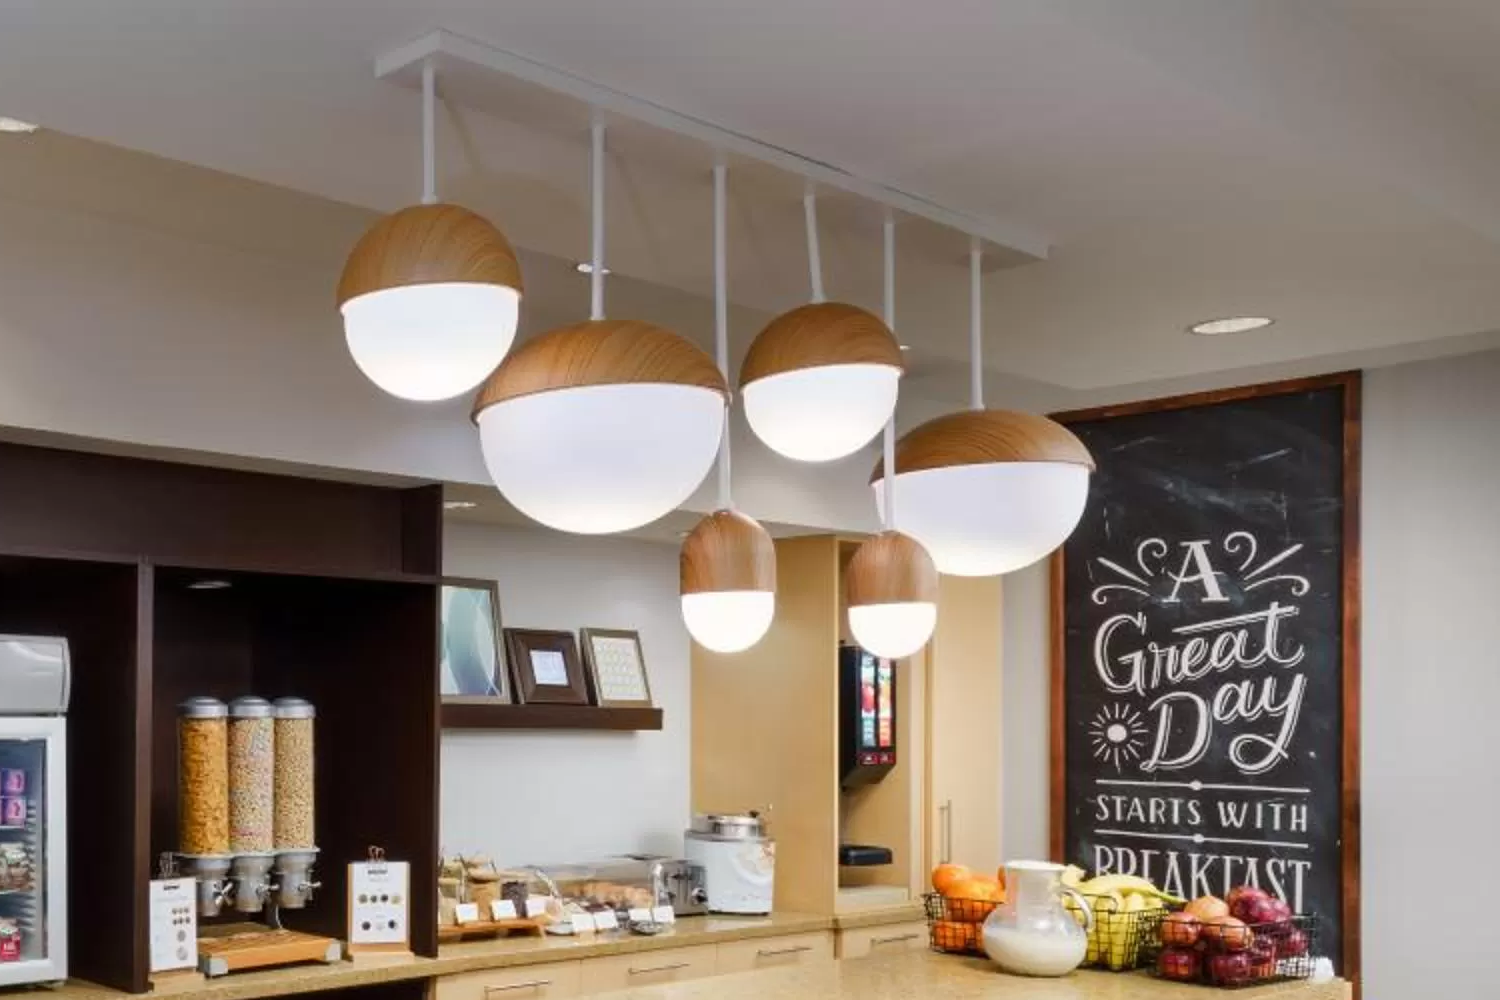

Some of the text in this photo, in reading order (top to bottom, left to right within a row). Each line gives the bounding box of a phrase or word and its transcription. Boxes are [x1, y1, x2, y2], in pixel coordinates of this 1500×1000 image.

[1161, 539, 1230, 603] A
[1094, 601, 1304, 697] Great
[1140, 673, 1308, 775] Day
[1095, 794, 1308, 833] STARTS WITH
